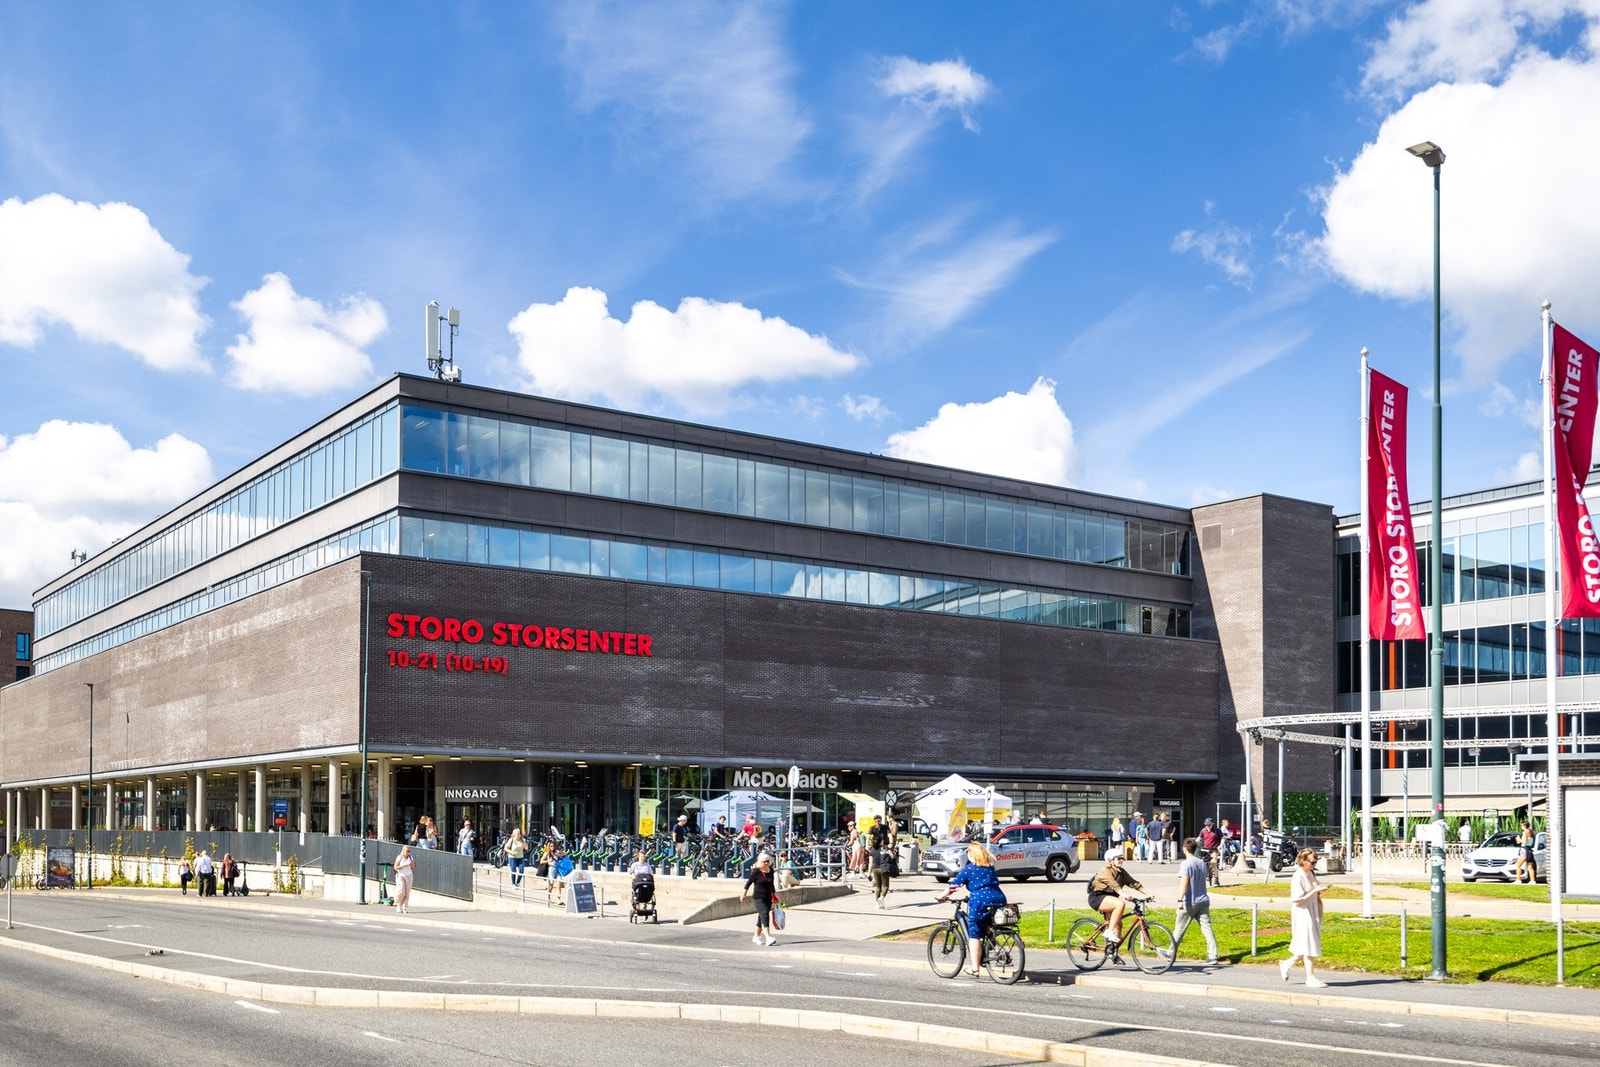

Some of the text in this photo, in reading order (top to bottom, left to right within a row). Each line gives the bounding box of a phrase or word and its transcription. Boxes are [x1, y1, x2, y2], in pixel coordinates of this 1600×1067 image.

[1389, 545, 1413, 627] STORO
[387, 613, 652, 656] STORO STORSENTER
[387, 650, 509, 675] 10-21 (10-19)
[733, 770, 838, 789] McDoald's
[445, 789, 498, 798] INNGANG
[996, 852, 1025, 861] OsloTaxi
